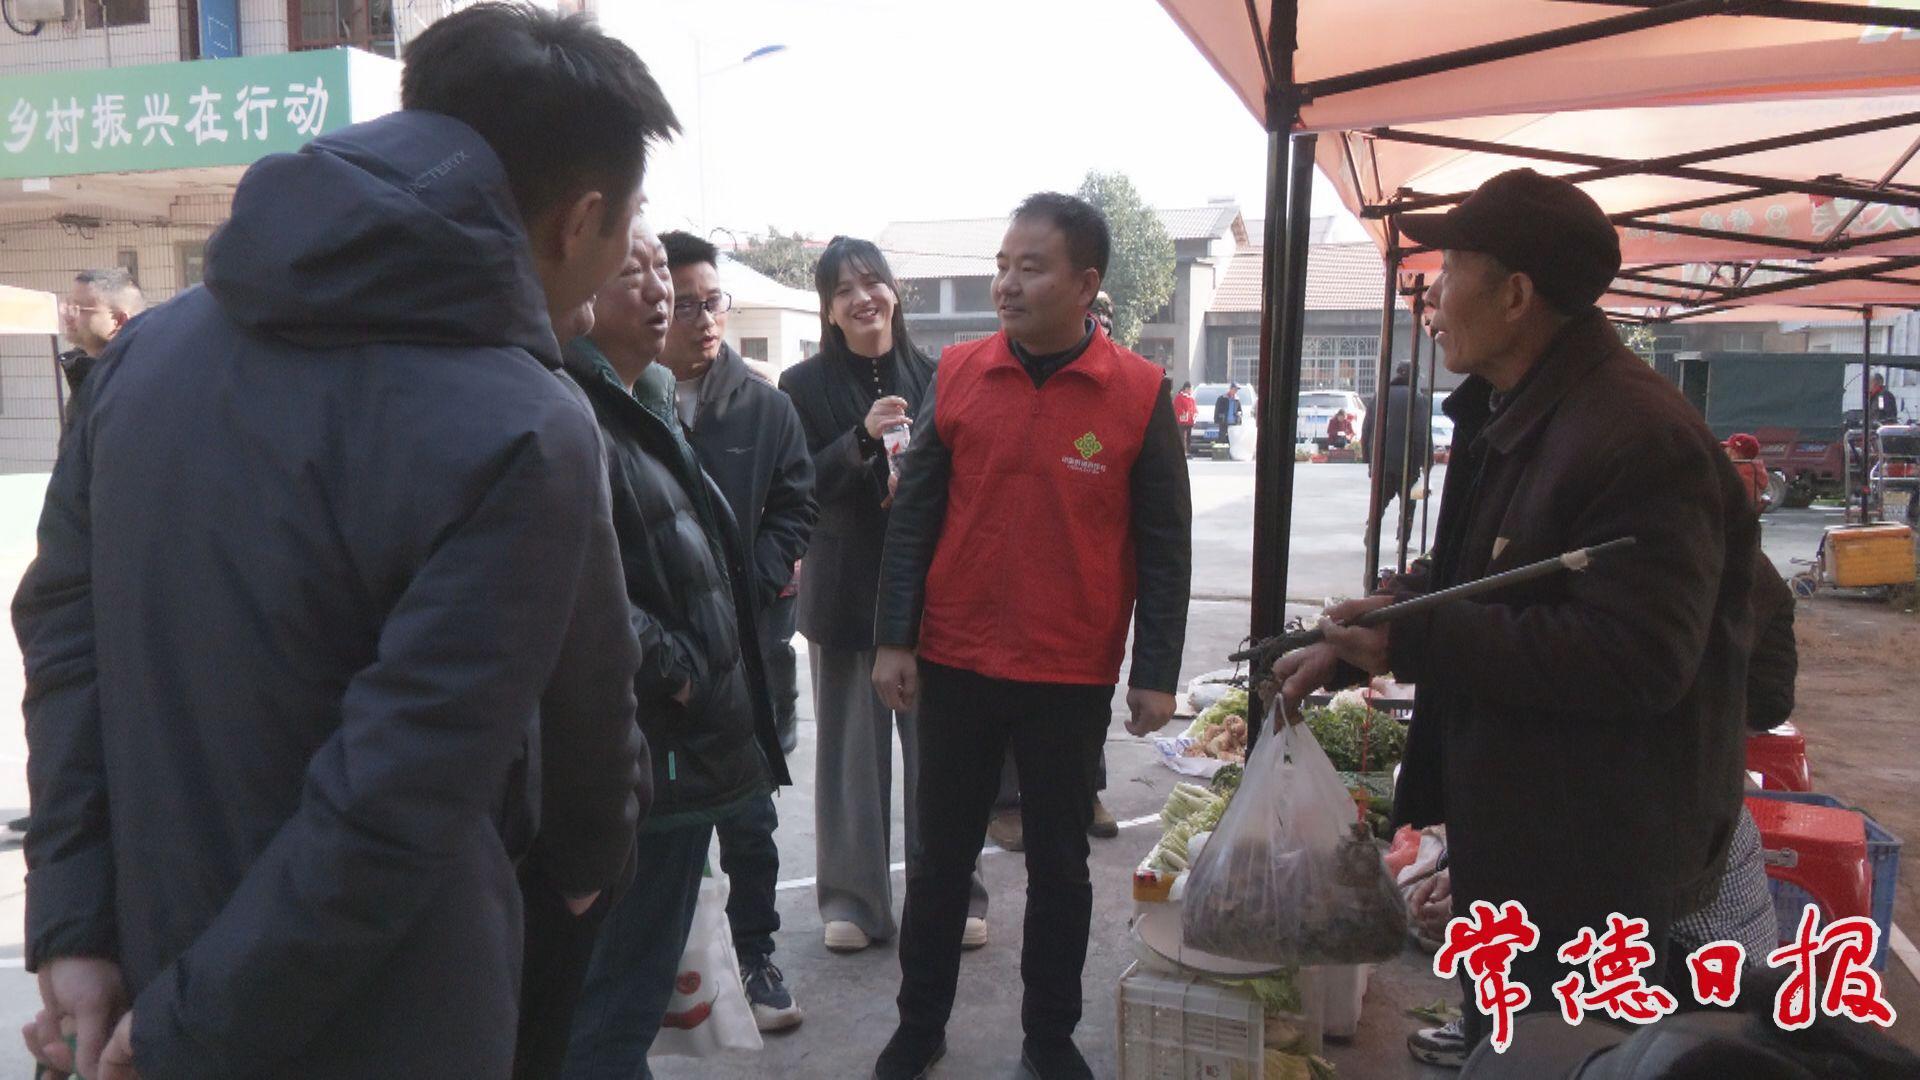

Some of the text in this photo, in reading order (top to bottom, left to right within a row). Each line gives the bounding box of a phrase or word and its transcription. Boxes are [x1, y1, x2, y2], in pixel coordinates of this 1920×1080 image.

[3, 77, 330, 153] 乡村振兴在行动
